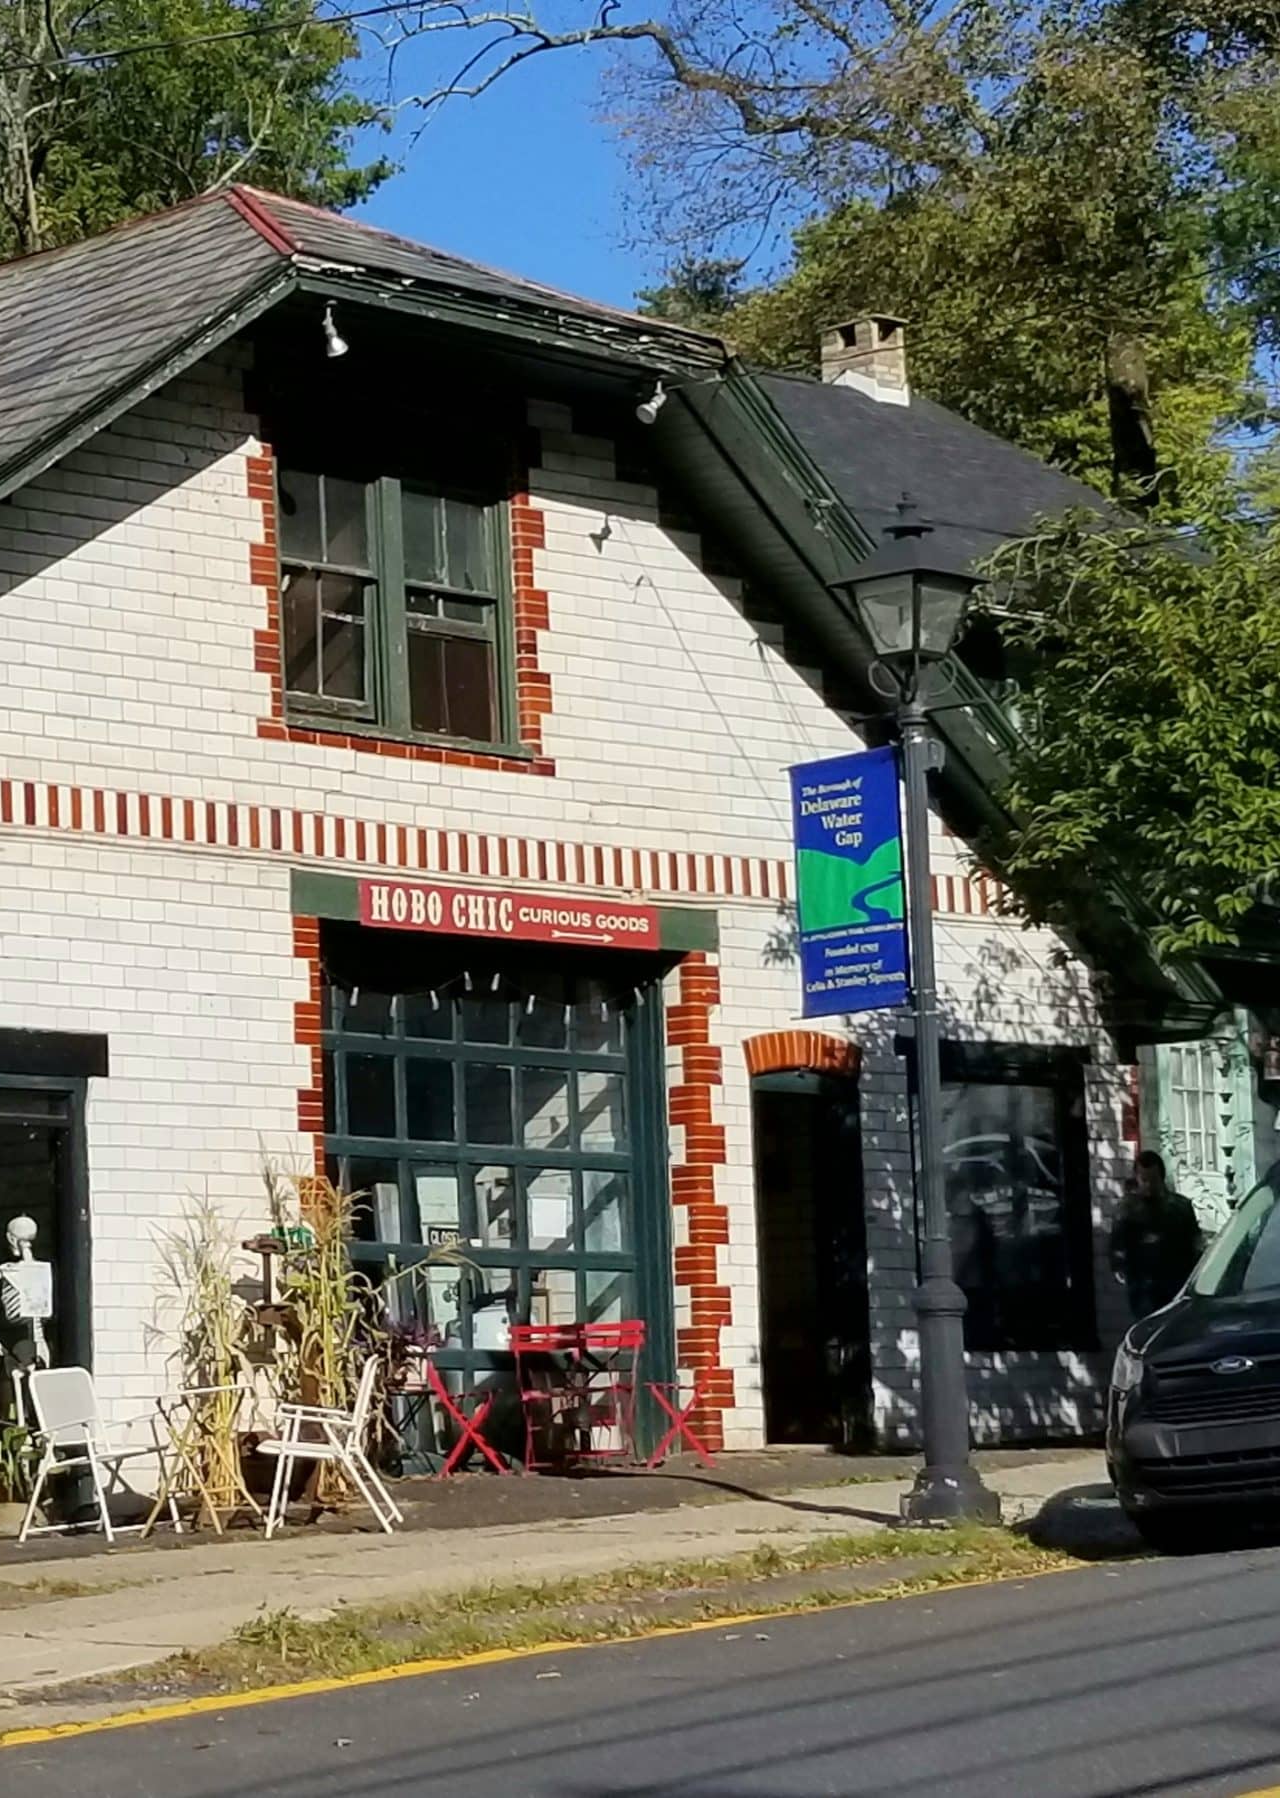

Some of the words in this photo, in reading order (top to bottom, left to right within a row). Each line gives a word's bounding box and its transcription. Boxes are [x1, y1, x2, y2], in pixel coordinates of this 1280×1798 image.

[800, 794, 863, 816] Delaware
[820, 812, 864, 830] Water
[835, 830, 864, 849] Gap
[370, 885, 443, 926] HOBO
[451, 893, 514, 933] CHIC
[519, 907, 592, 928] CURIOUS
[595, 913, 650, 933] GOODS
